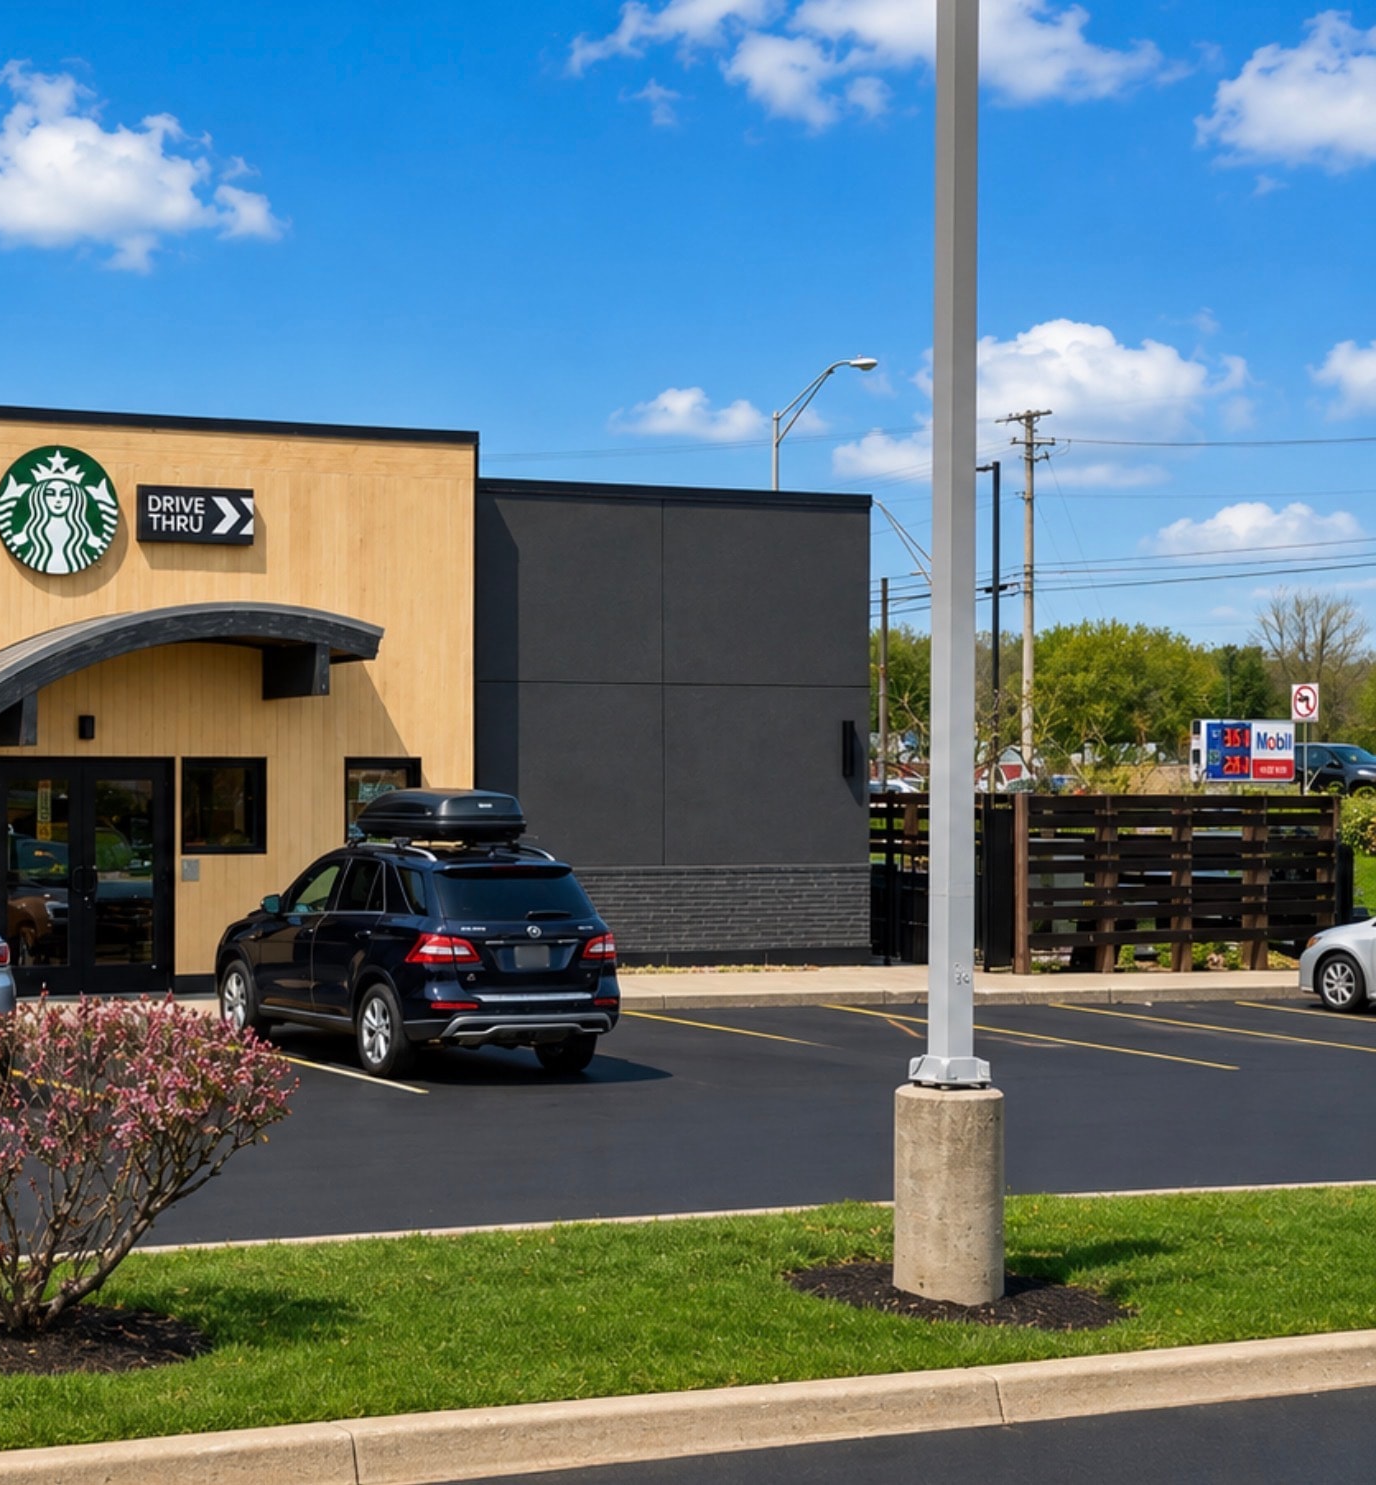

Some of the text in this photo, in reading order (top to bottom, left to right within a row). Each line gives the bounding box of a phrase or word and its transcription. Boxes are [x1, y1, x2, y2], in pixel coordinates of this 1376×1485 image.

[147, 494, 206, 514] DRIVE
[148, 514, 204, 533] THRU
[1256, 731, 1292, 751] Mobil
